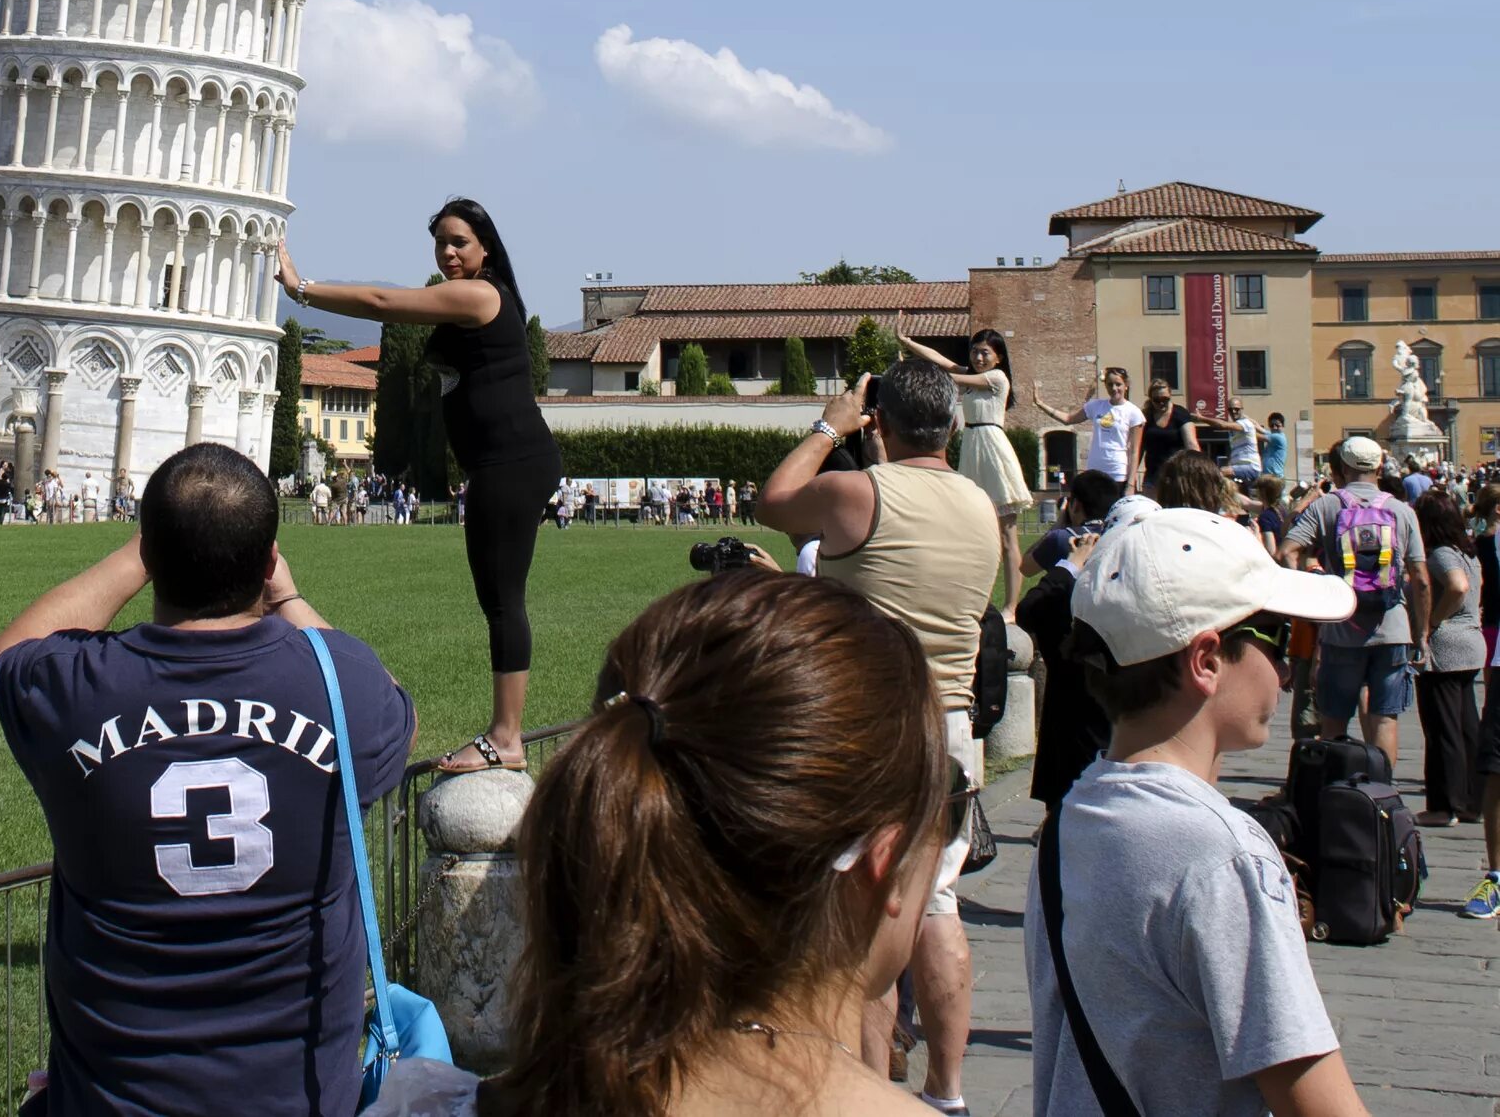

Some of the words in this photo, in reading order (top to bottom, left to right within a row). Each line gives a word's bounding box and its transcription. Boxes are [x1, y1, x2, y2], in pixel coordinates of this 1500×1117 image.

[1211, 274, 1222, 313] Duomo
[1212, 315, 1223, 330] del
[1213, 333, 1227, 383] dell'Opera
[1215, 385, 1226, 419] Museo
[151, 757, 274, 896] 3
